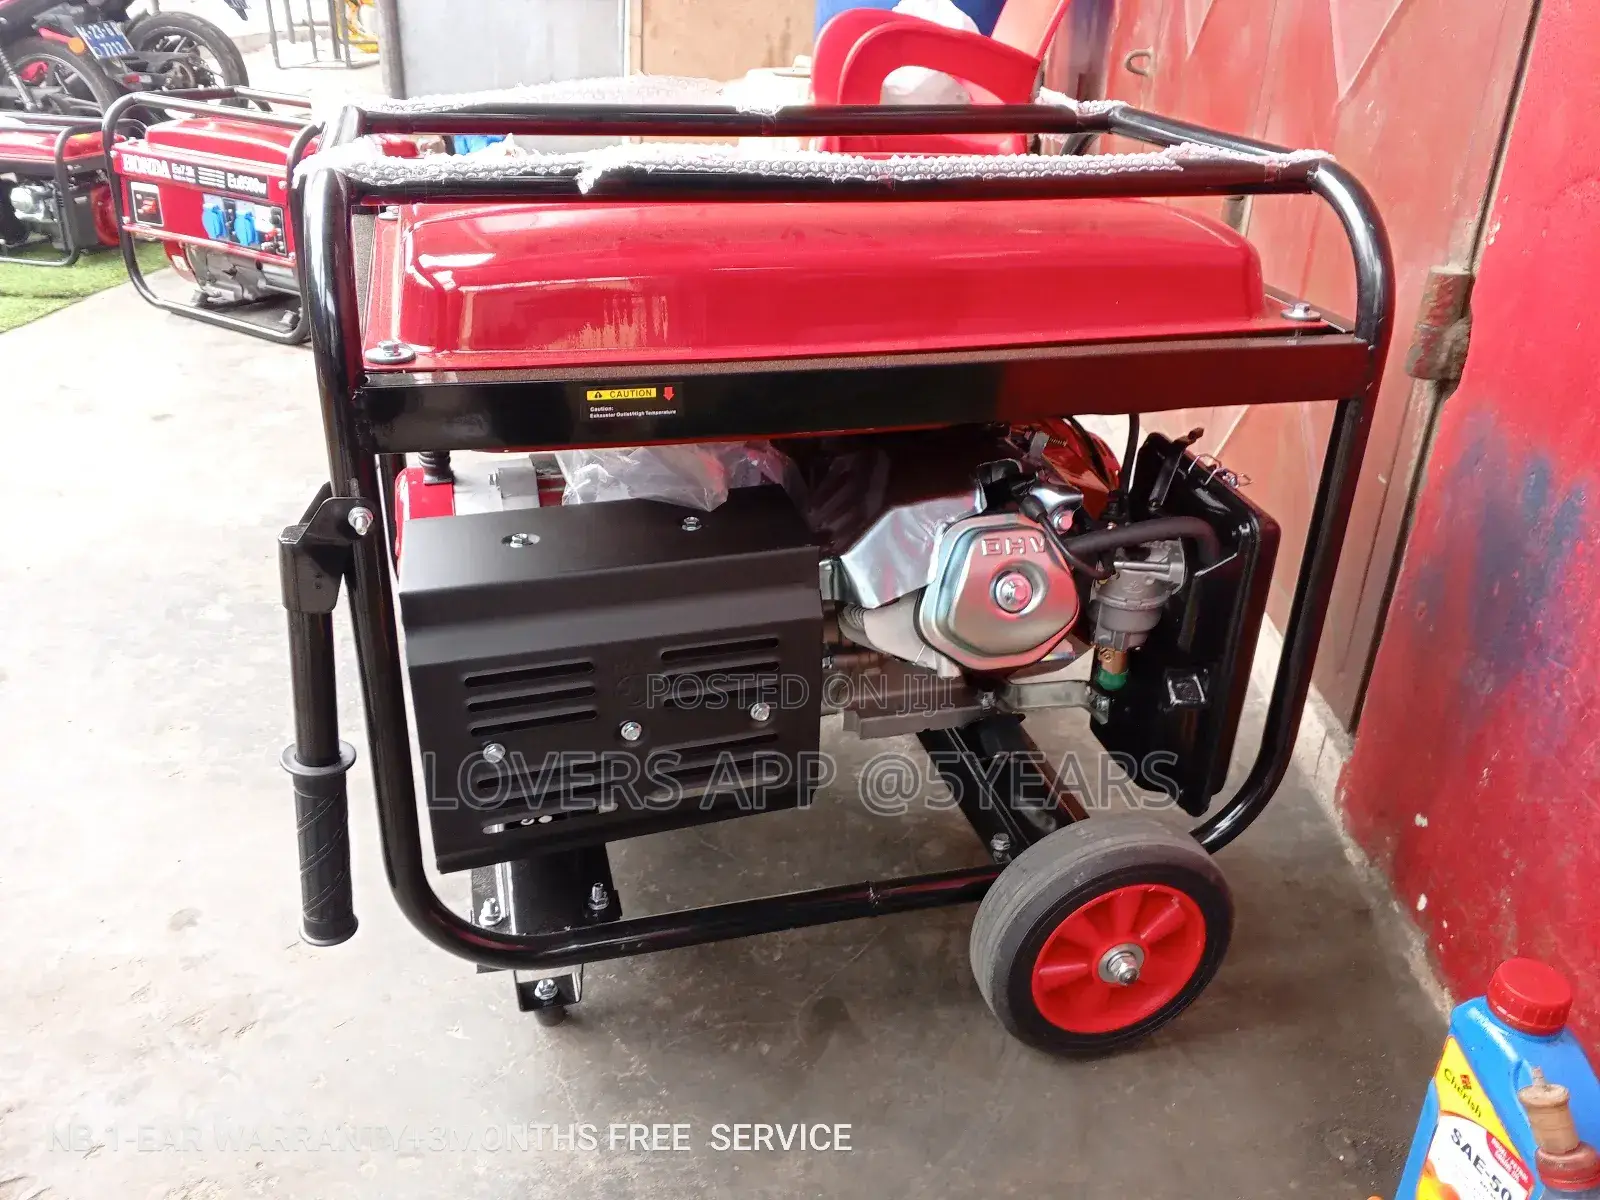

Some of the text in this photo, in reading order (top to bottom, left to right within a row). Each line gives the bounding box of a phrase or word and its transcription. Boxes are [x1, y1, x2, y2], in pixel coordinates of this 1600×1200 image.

[121, 153, 171, 179] HONDA
[609, 389, 652, 398] CAUTION
[1443, 1068, 1481, 1118] Cherish
[1451, 1128, 1512, 1200] SAE-50
